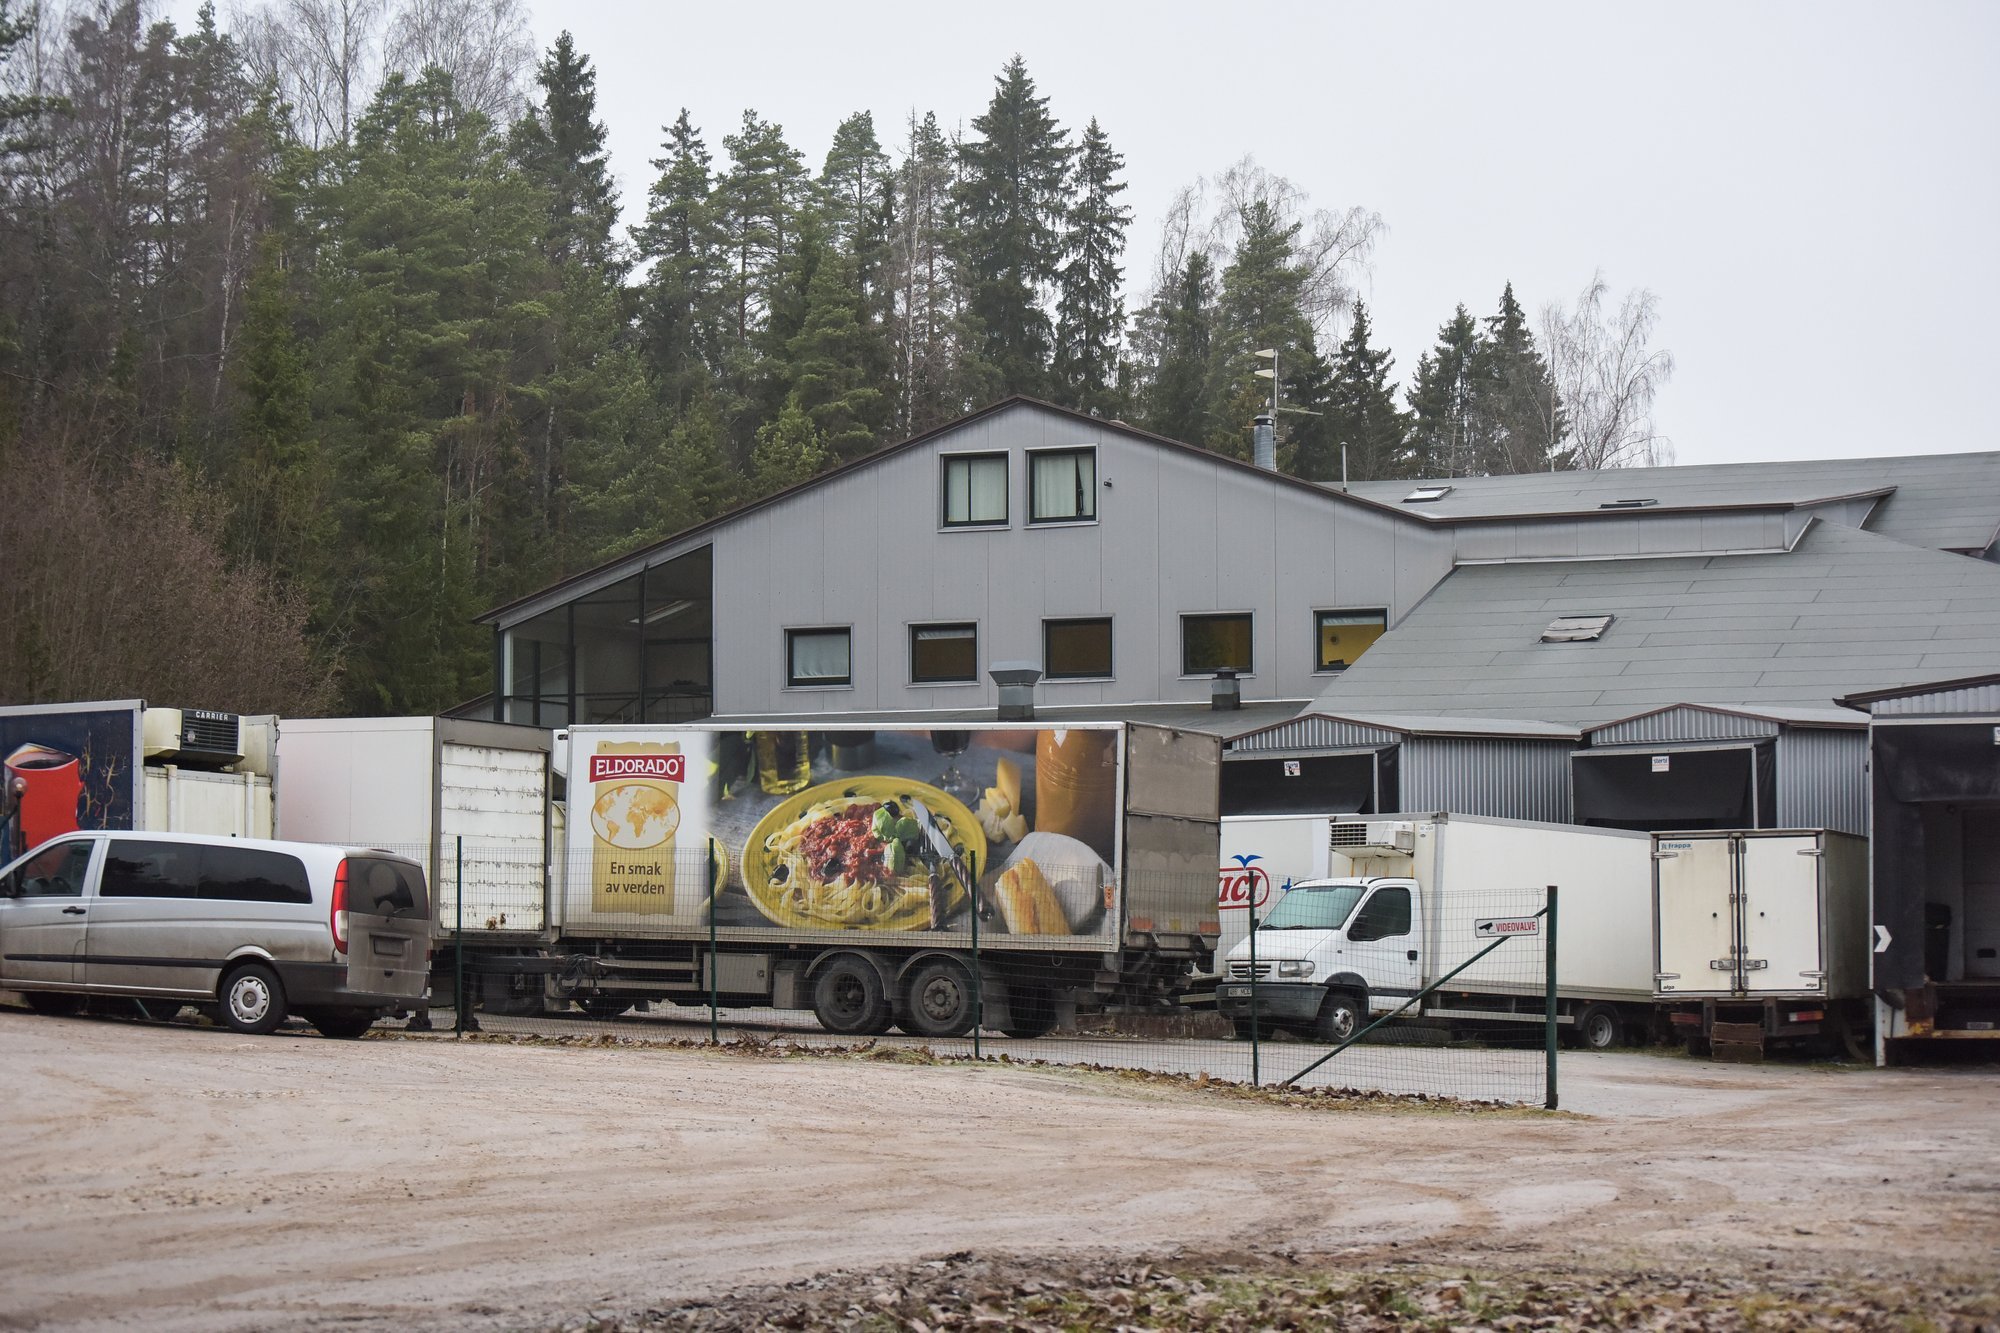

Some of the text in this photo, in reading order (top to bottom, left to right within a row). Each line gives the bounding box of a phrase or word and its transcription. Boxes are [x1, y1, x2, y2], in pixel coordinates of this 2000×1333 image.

[195, 711, 229, 721] CARRIER
[595, 758, 679, 776] ELDORADO
[610, 861, 662, 876] En smak
[605, 880, 665, 895] av verden
[1219, 875, 1261, 902] ICI
[1496, 921, 1536, 932] VIDEOVALVE
